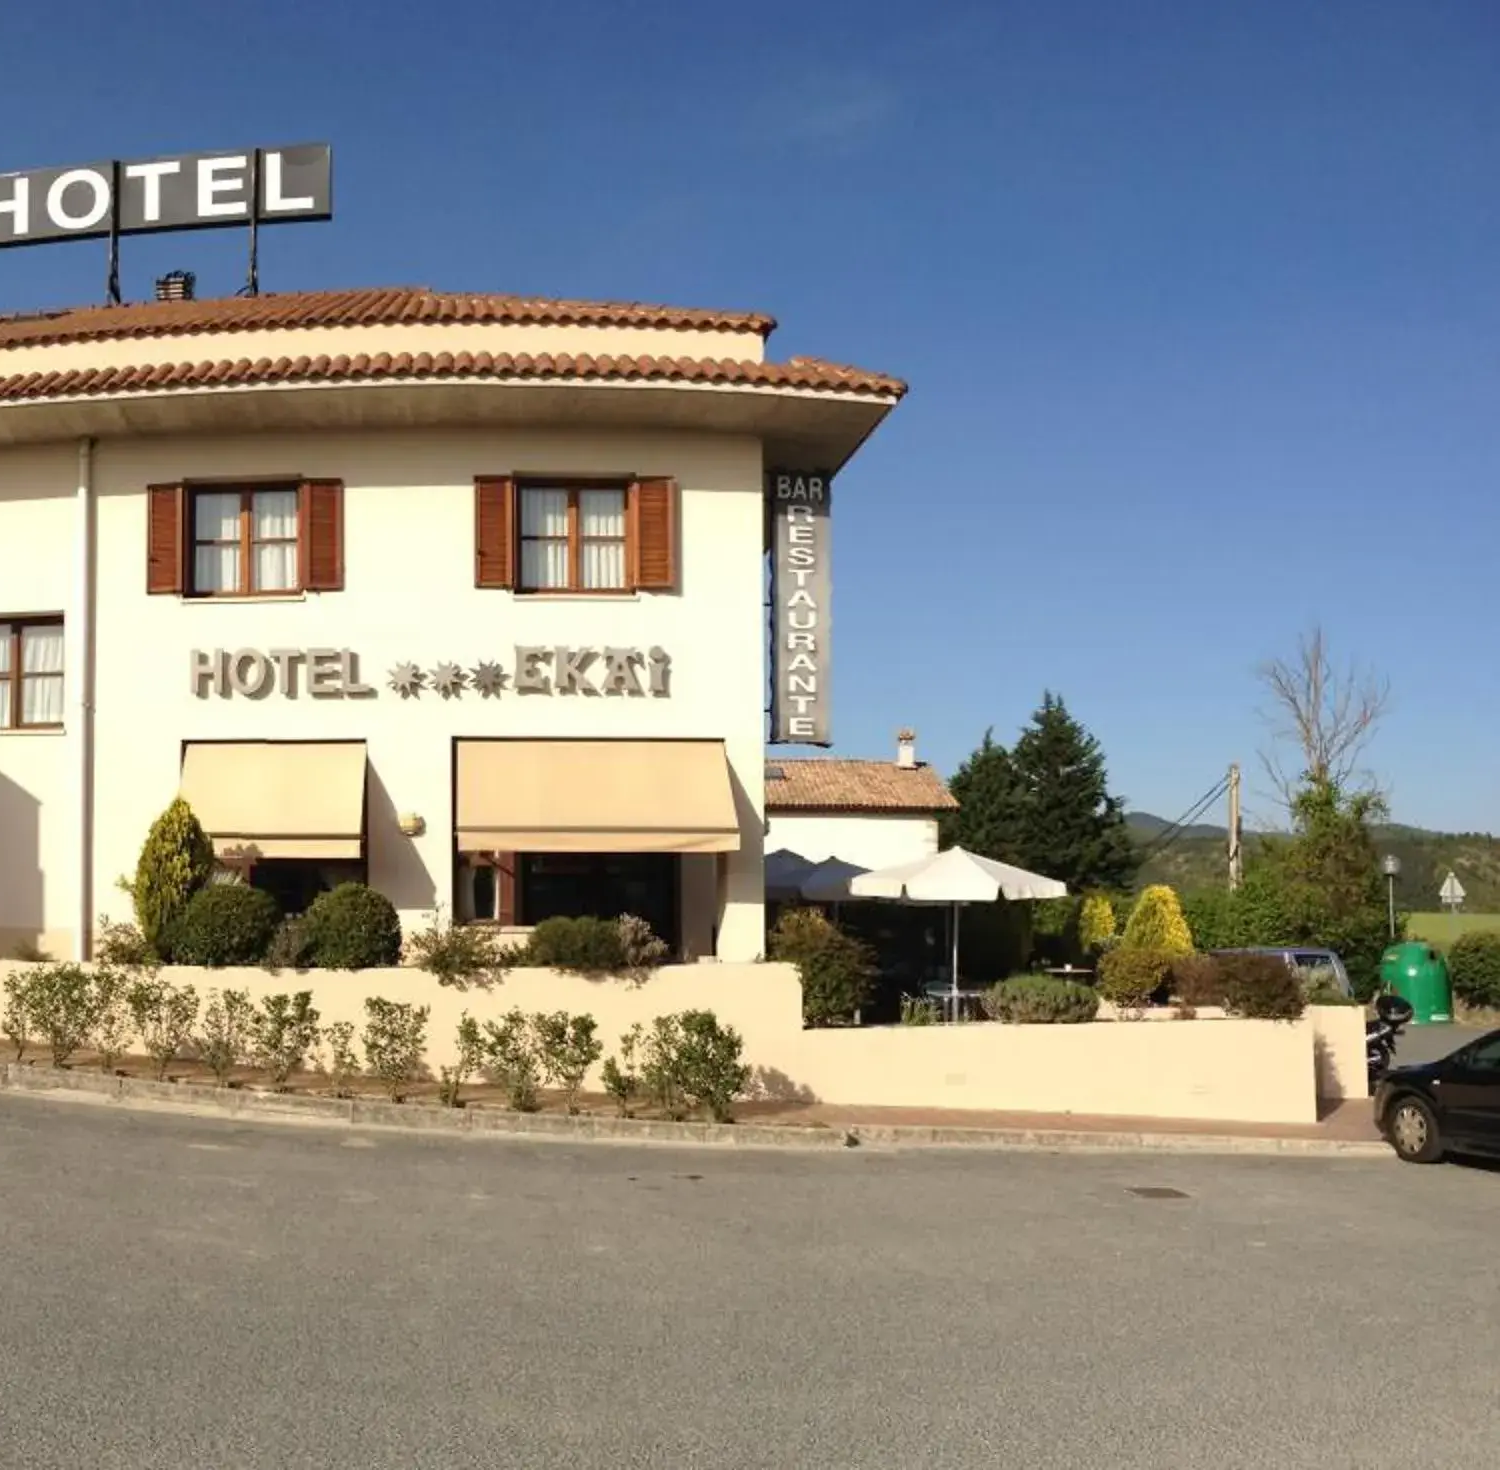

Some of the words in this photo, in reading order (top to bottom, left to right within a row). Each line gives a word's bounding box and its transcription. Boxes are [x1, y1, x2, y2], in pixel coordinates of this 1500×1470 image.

[777, 476, 822, 501] BAR
[787, 505, 817, 736] RESTAURANTE
[190, 647, 378, 699] HOTEL
